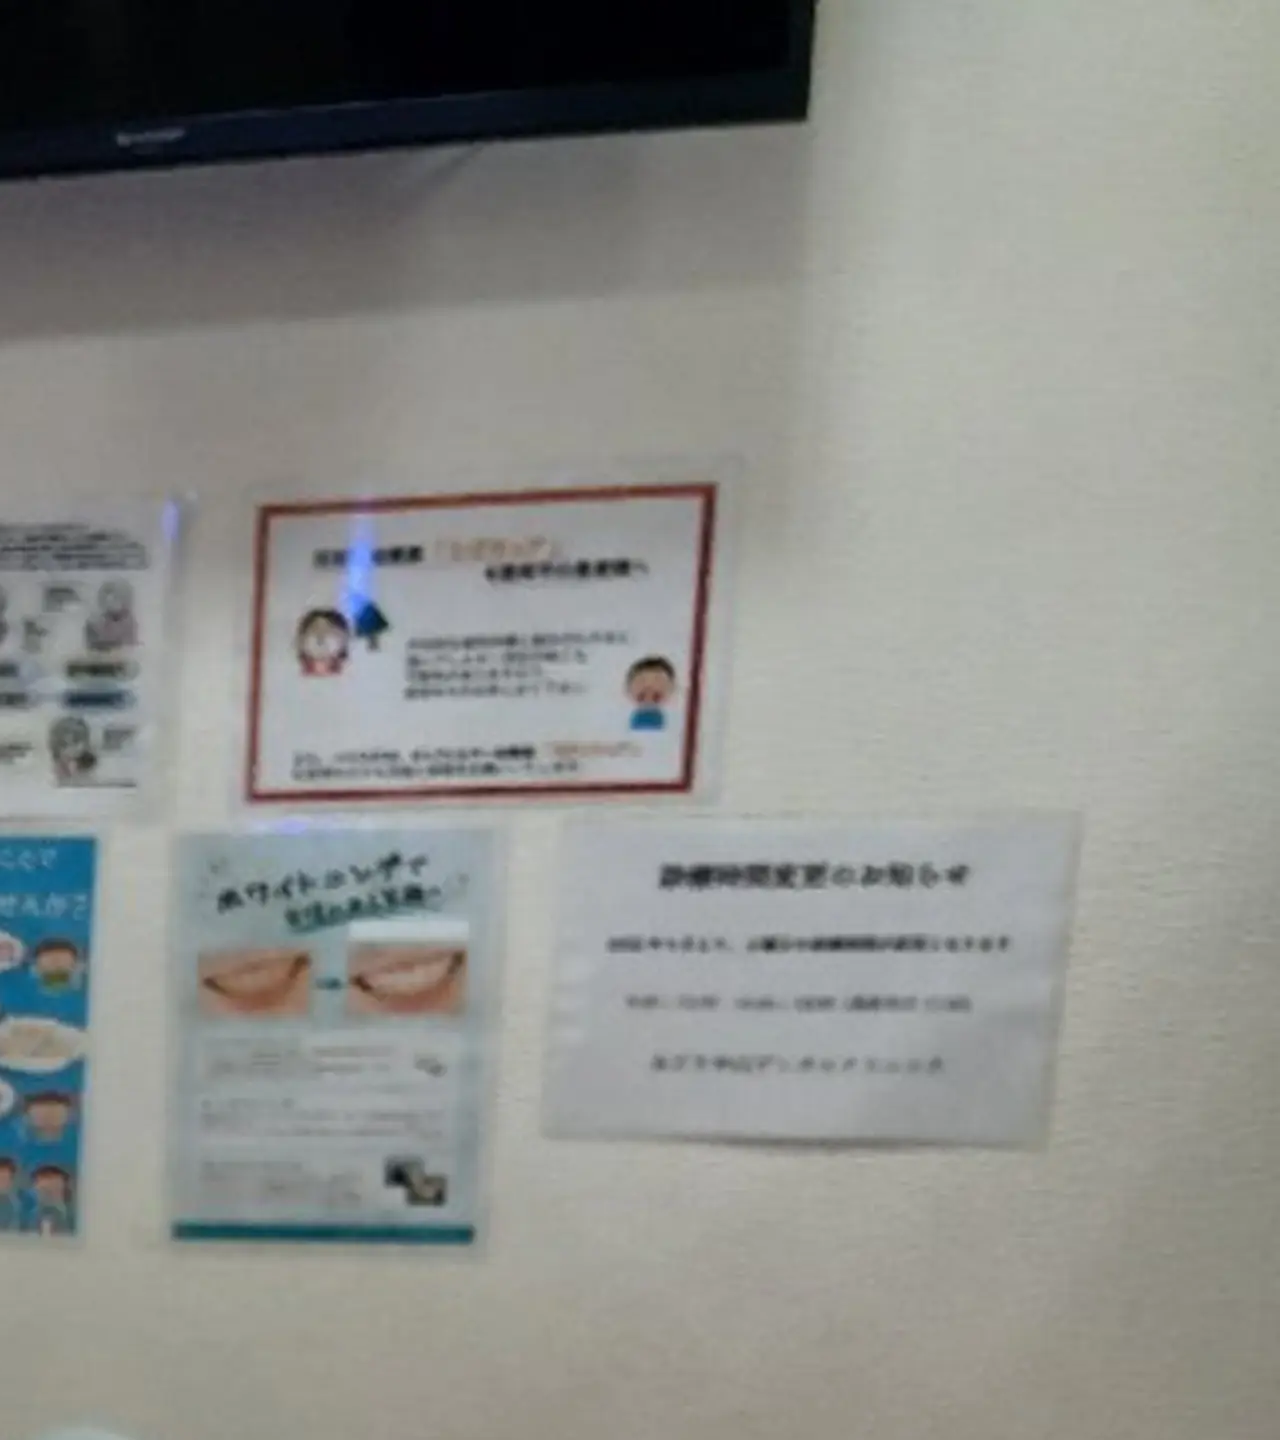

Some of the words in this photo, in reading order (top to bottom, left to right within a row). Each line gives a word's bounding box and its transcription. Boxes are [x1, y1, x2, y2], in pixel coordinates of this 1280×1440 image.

[658, 862, 970, 889] 診療時間変更のお知らせ
